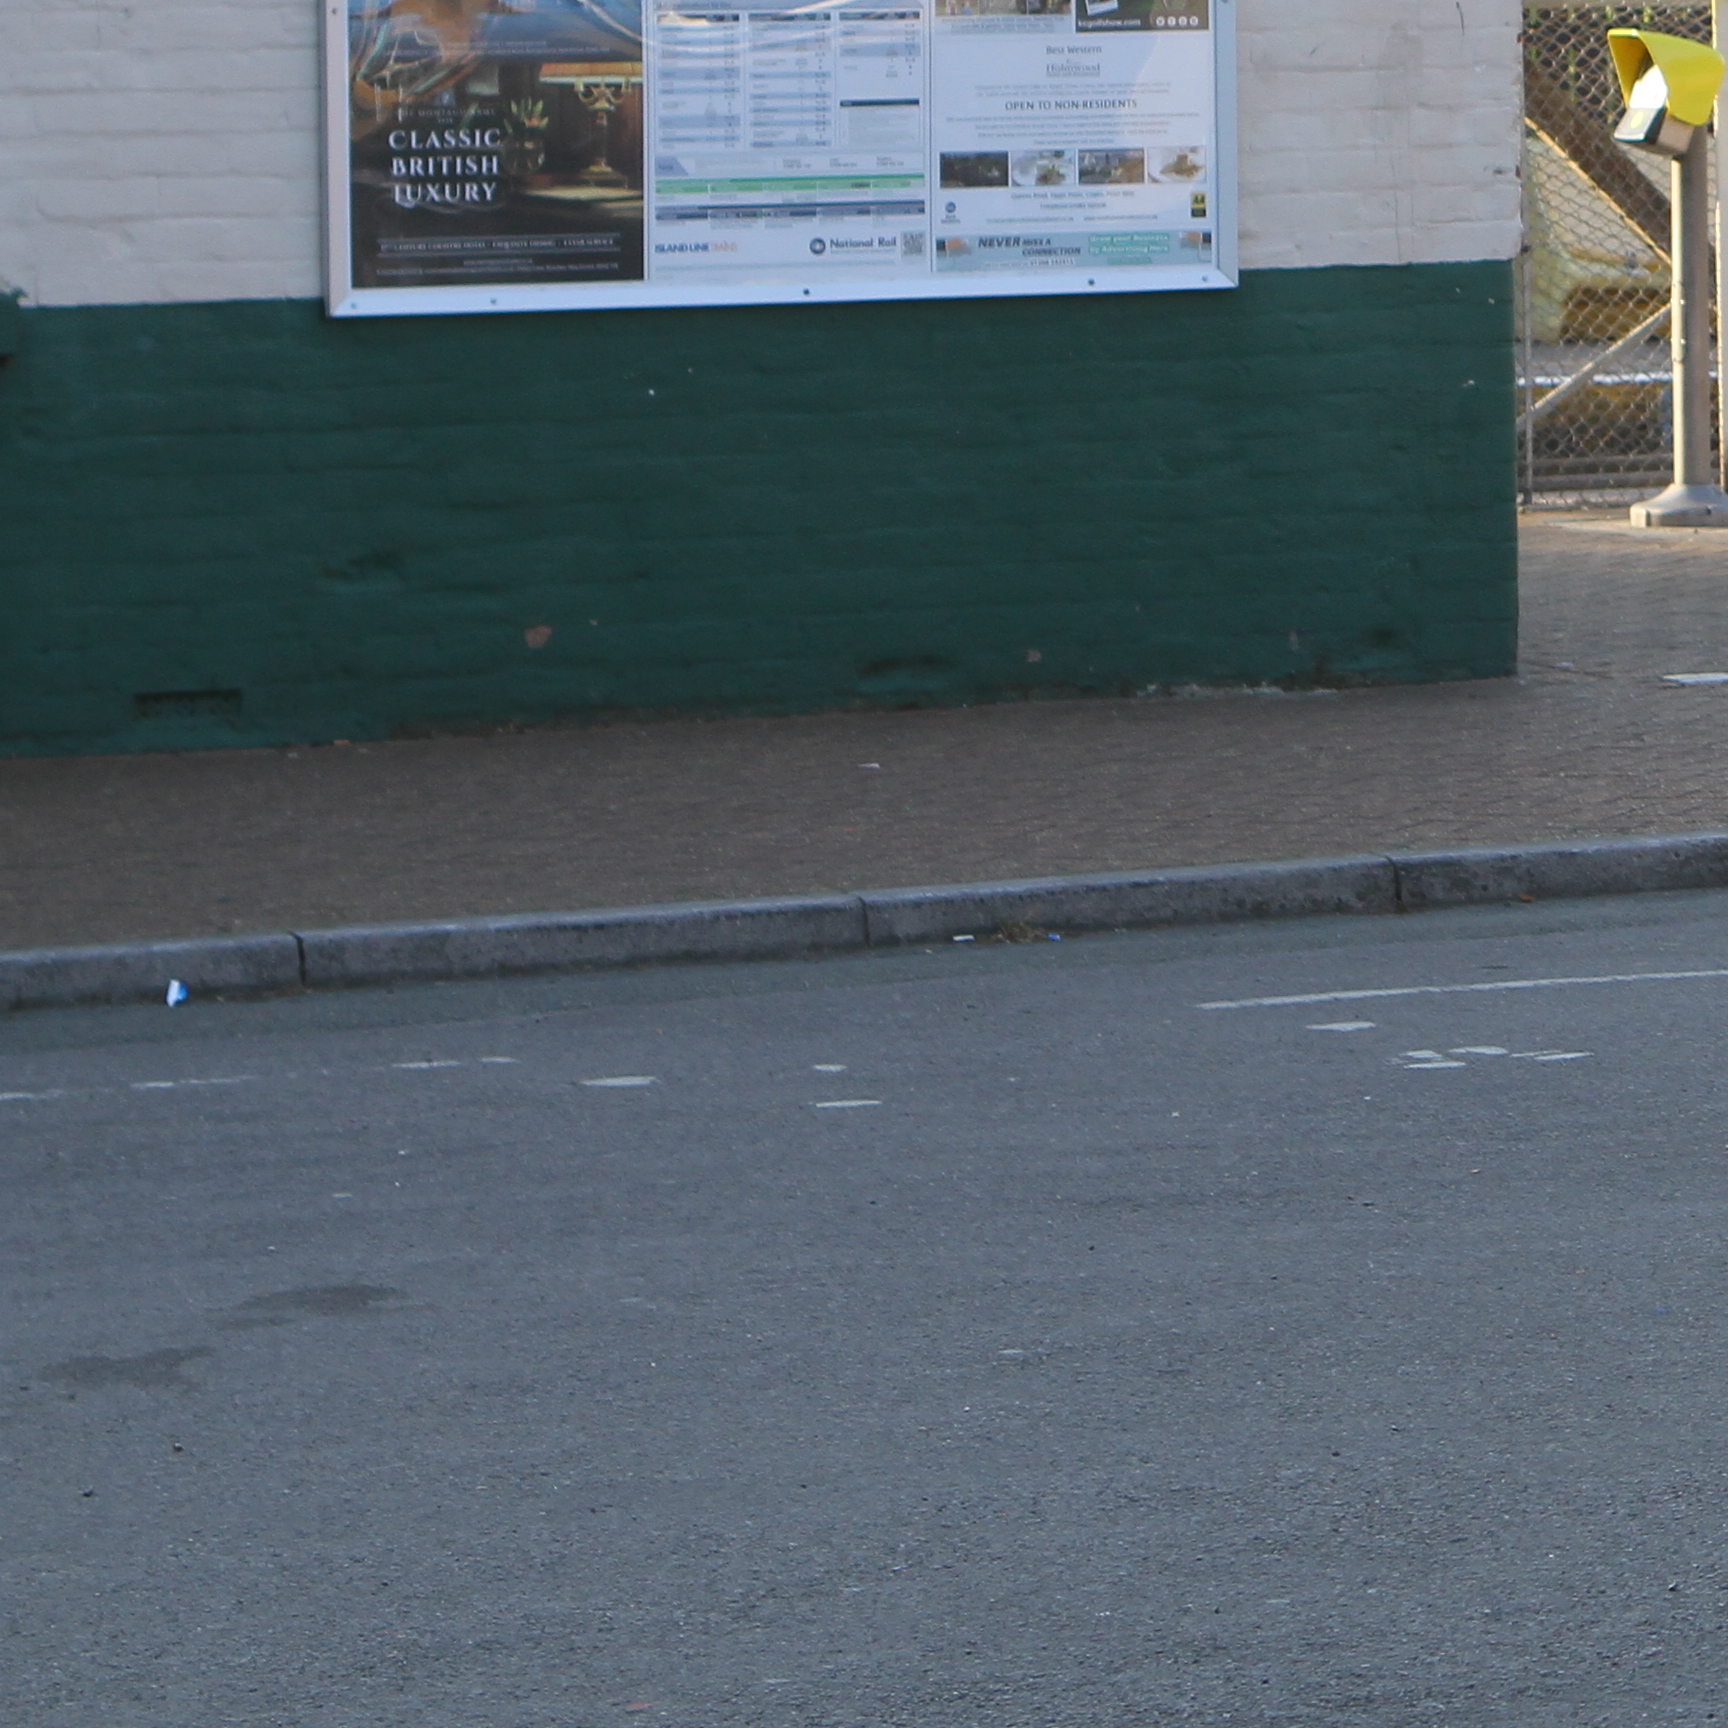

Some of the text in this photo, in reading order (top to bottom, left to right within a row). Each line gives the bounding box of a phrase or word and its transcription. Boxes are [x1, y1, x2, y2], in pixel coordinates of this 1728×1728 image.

[1005, 98, 1138, 111] OPEN TO NON-RESIDENTS
[388, 128, 501, 151] CLASSIC
[391, 155, 499, 177] BRITISH
[393, 181, 498, 203] LUXURY
[829, 237, 897, 249] National Rail
[978, 236, 1020, 249] NEVER
